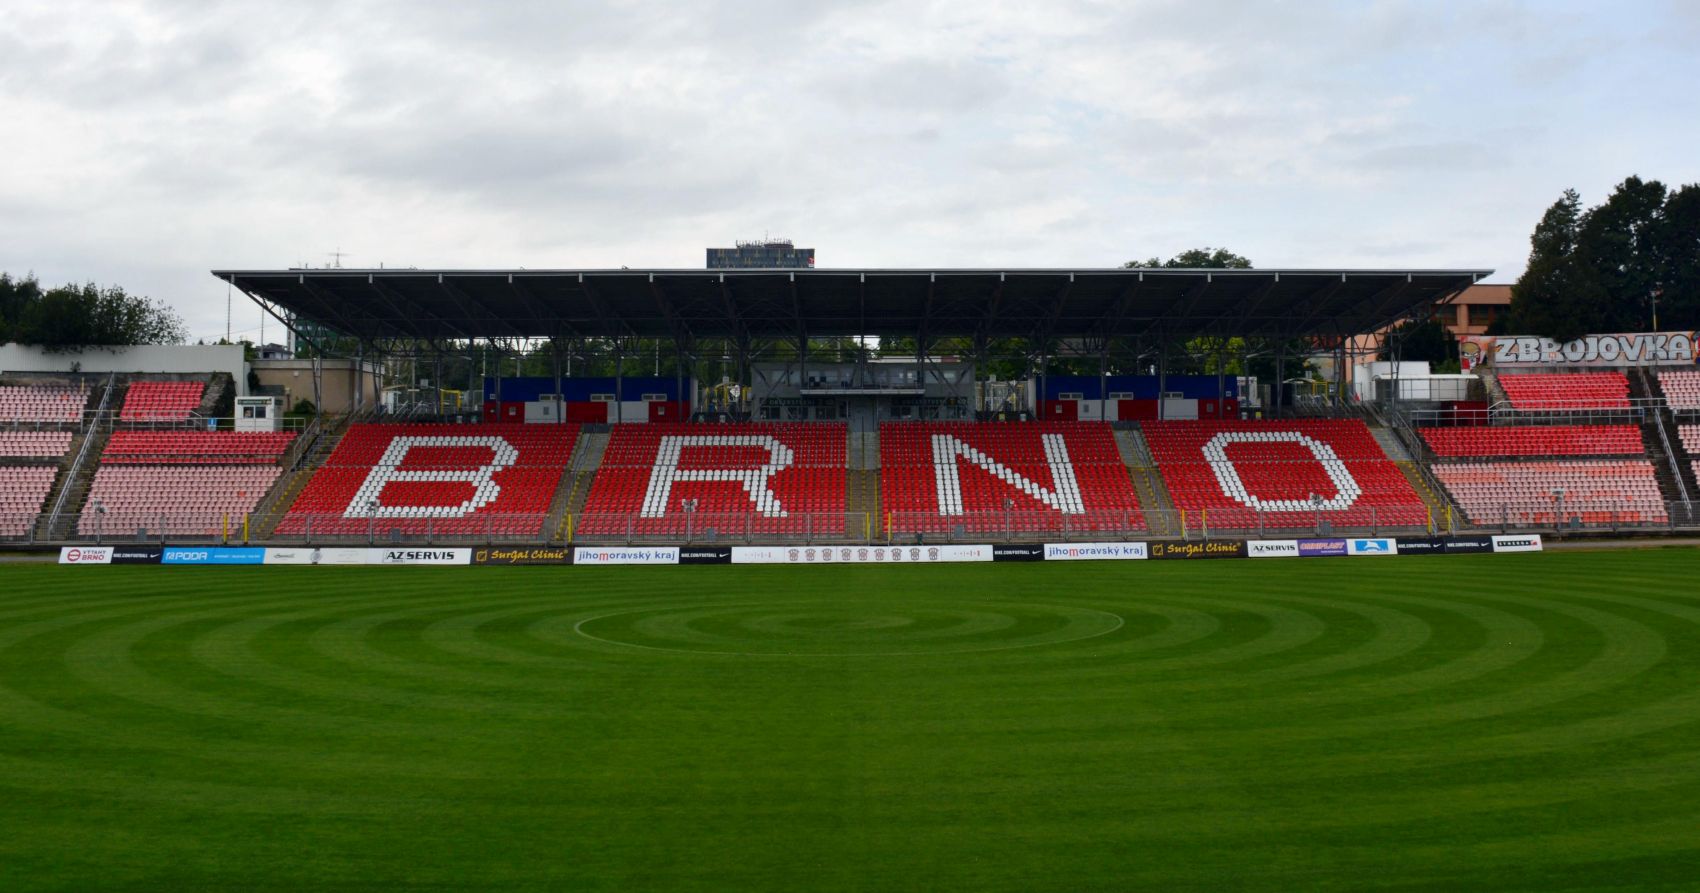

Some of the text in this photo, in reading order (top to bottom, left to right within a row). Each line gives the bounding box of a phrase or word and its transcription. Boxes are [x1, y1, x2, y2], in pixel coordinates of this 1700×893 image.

[1495, 334, 1692, 364] ZBROJOVKA
[1048, 545, 1144, 557] jihomoravský kraj
[1264, 544, 1296, 552] SERVIS
[386, 551, 455, 560] AZ SERVIS
[578, 550, 676, 562] jihomoravský kraj
